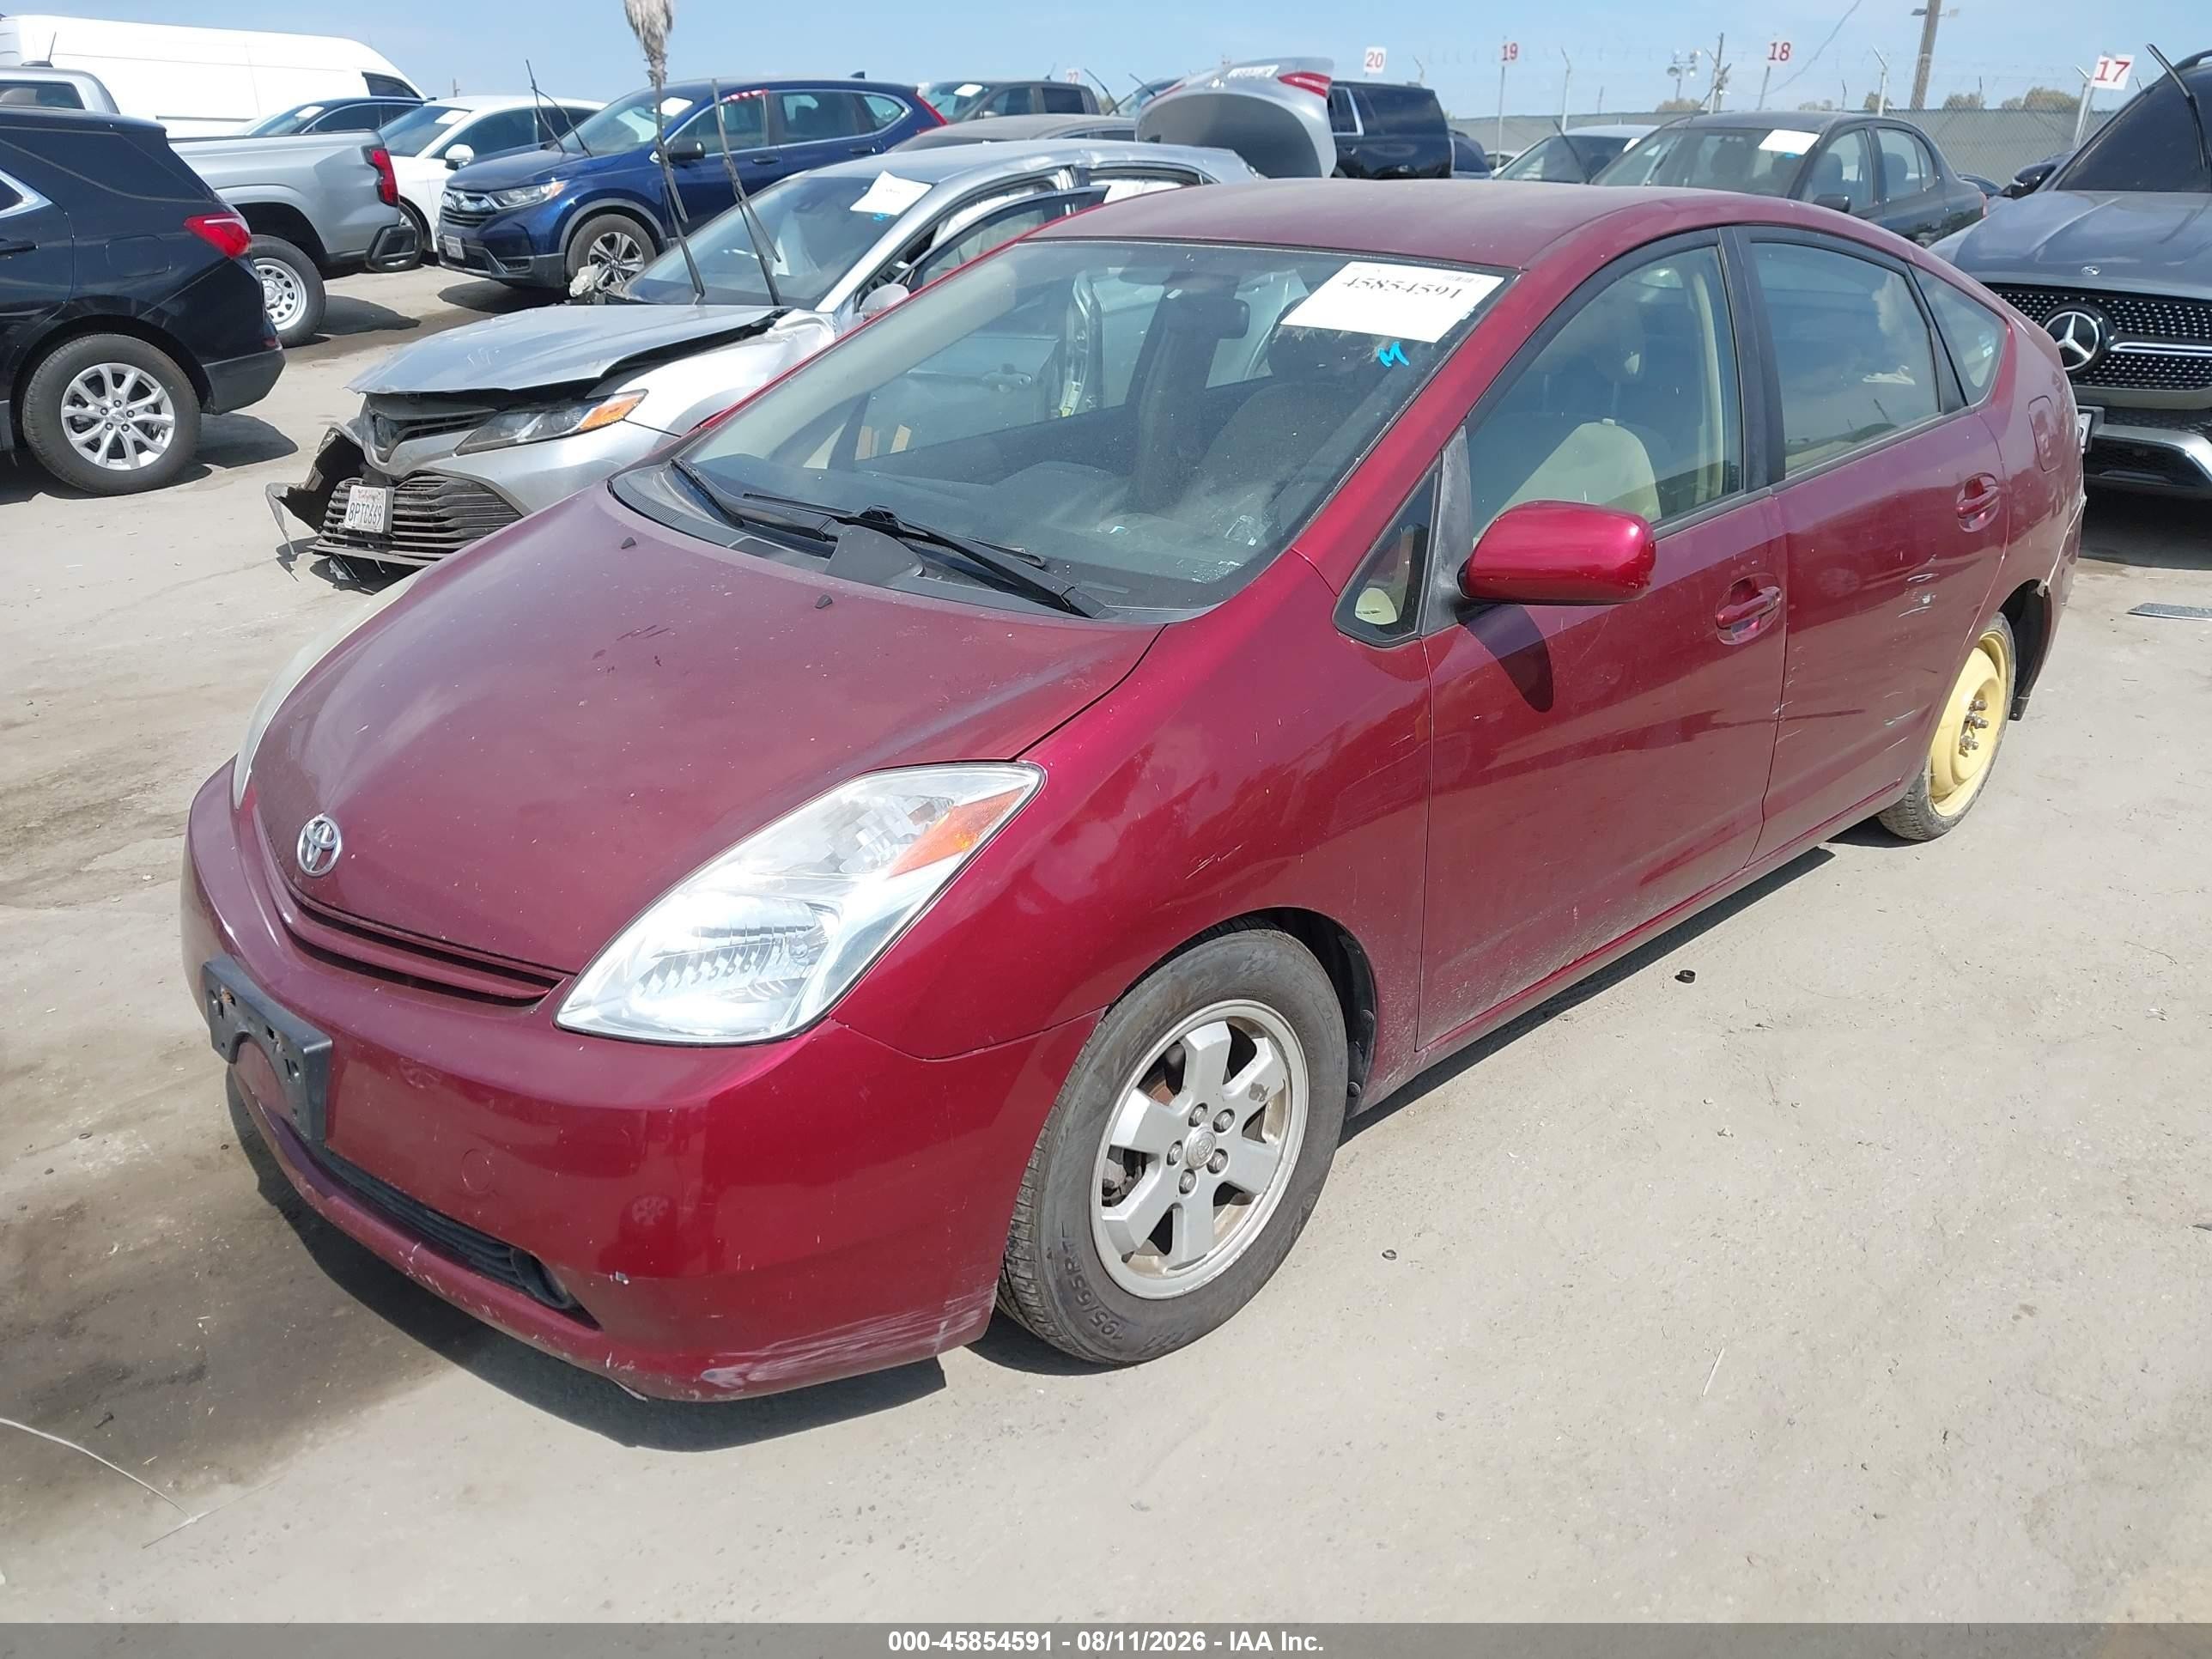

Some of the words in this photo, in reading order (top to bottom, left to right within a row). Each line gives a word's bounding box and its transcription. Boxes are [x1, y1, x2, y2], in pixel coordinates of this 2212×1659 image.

[1366, 52, 1383, 68] 20
[1502, 43, 1518, 61] 19
[1767, 42, 1791, 61] 18
[2094, 60, 2130, 82] 17
[348, 501, 383, 526] 8PTC669
